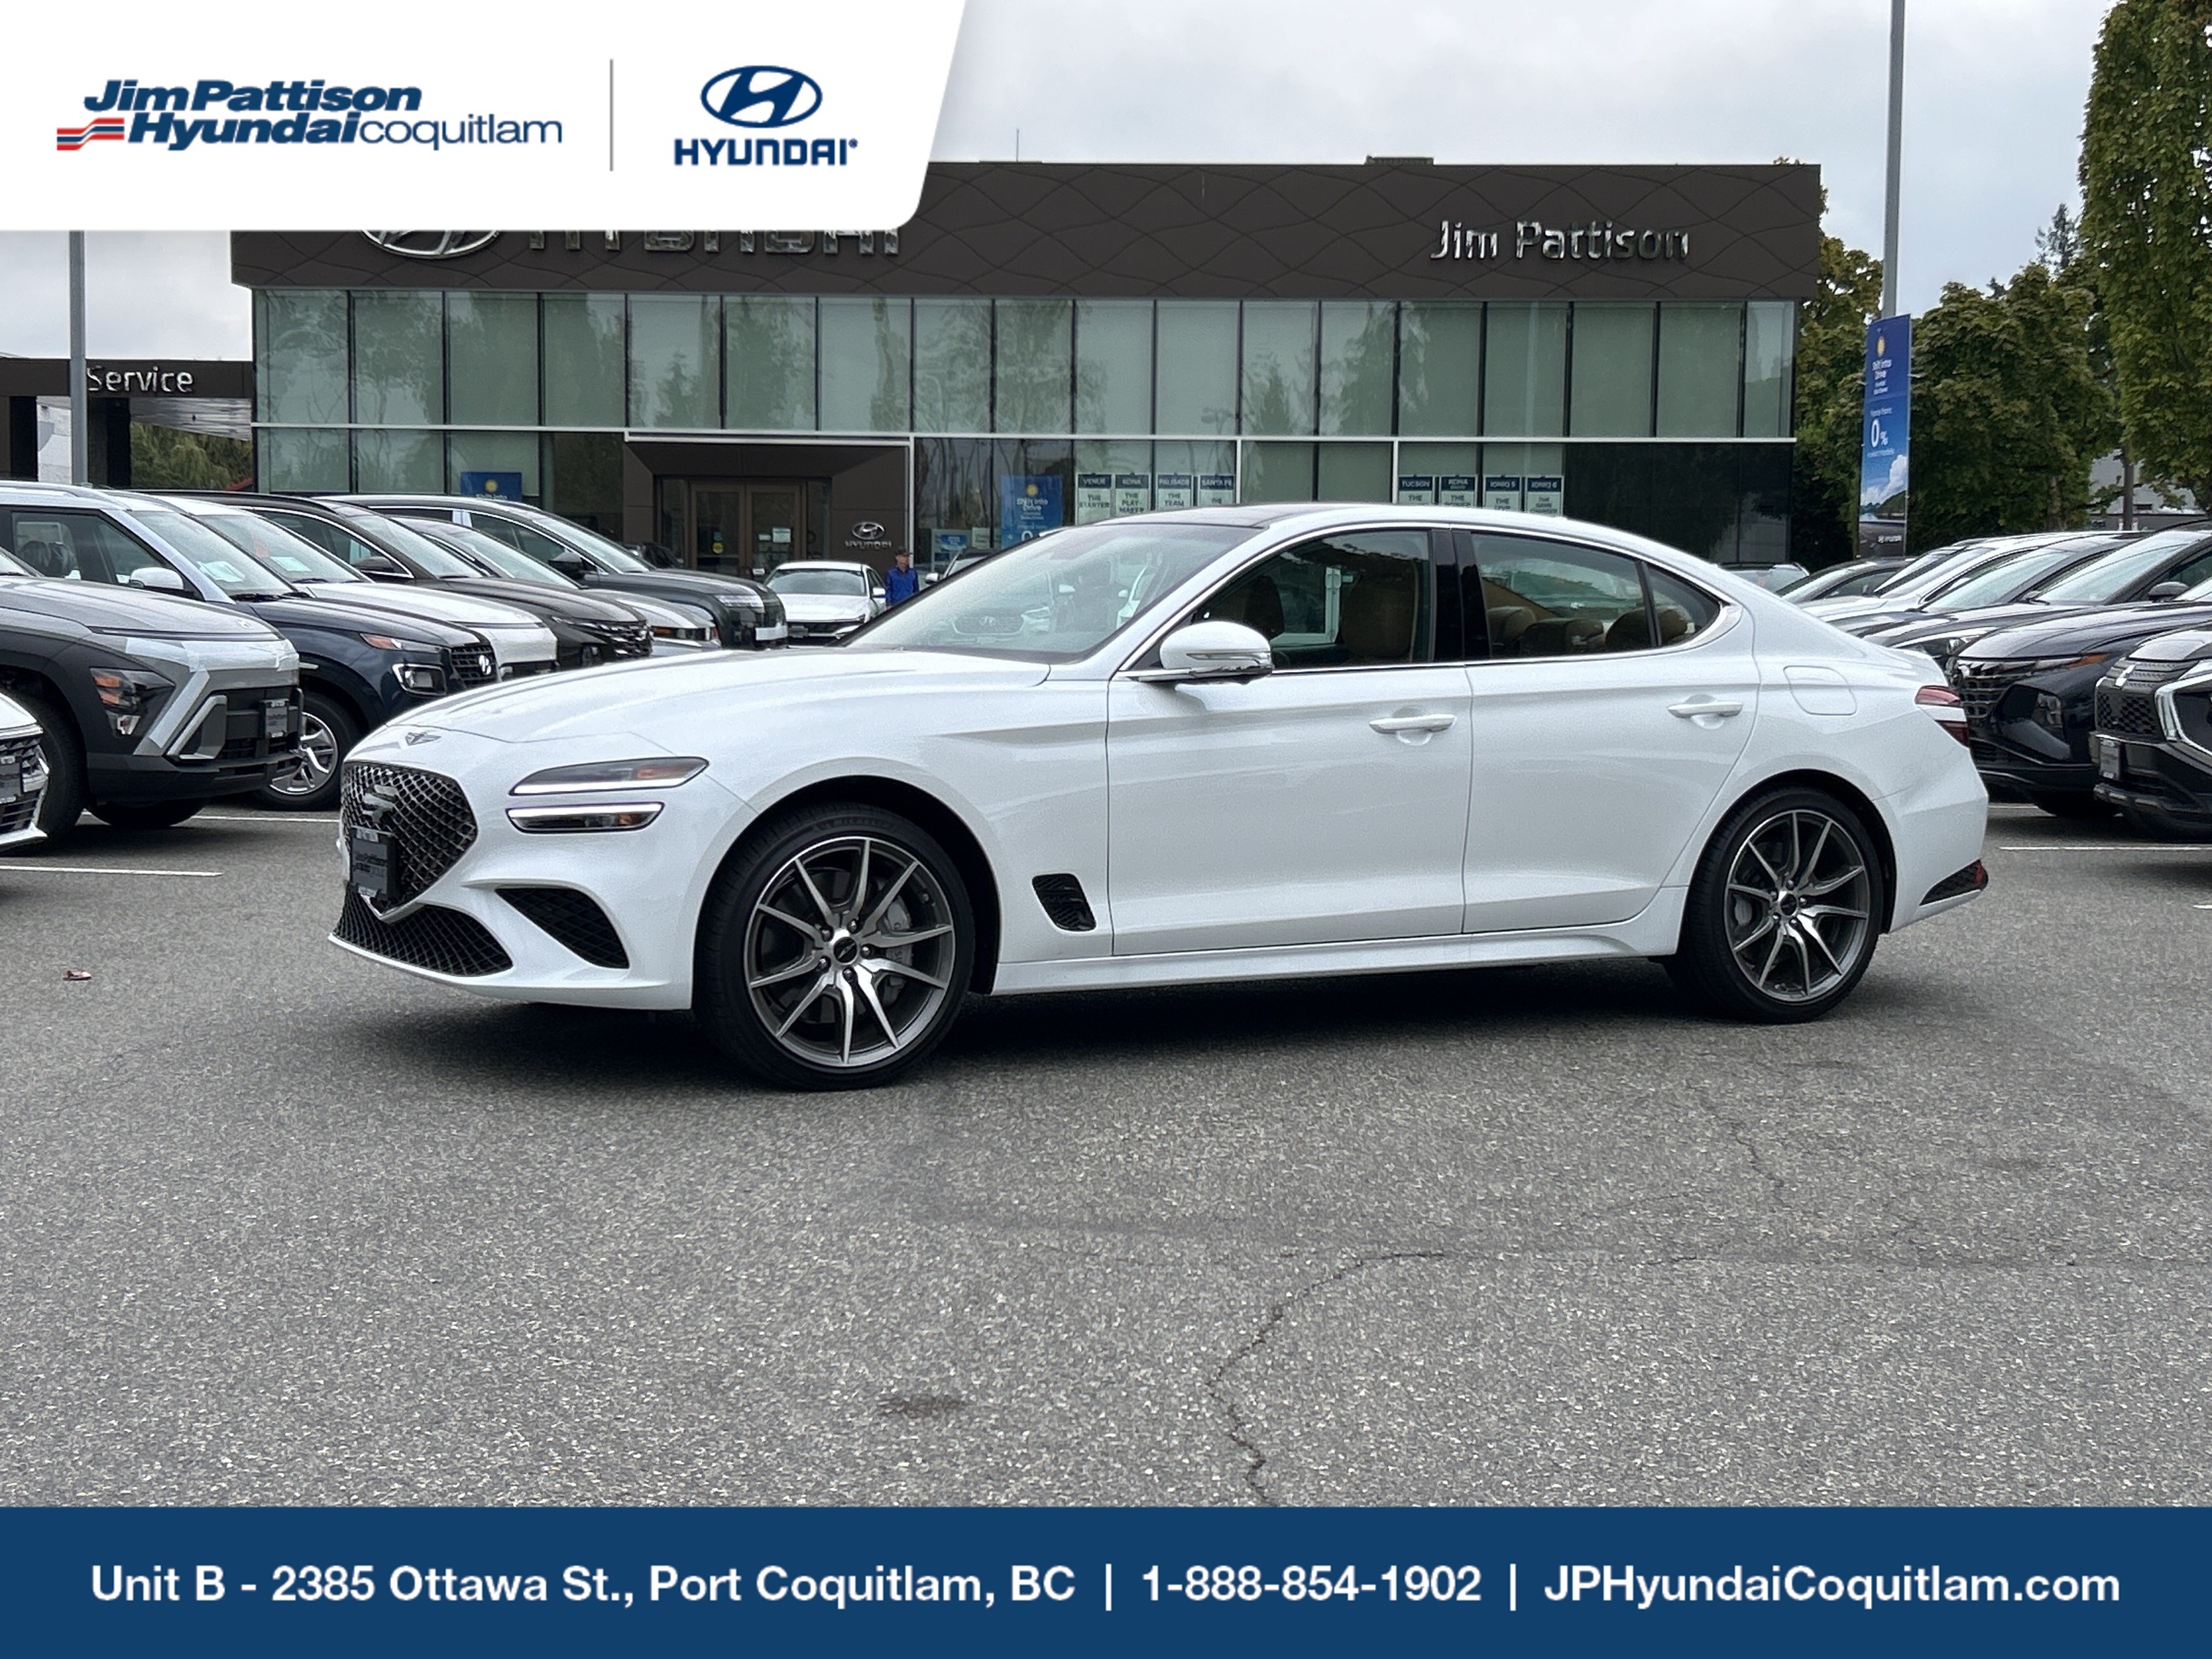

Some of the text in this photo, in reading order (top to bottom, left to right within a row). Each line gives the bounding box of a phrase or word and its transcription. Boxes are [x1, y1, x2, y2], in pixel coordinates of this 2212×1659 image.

[1431, 220, 1689, 258] Jim Pattison
[86, 365, 194, 392] Service
